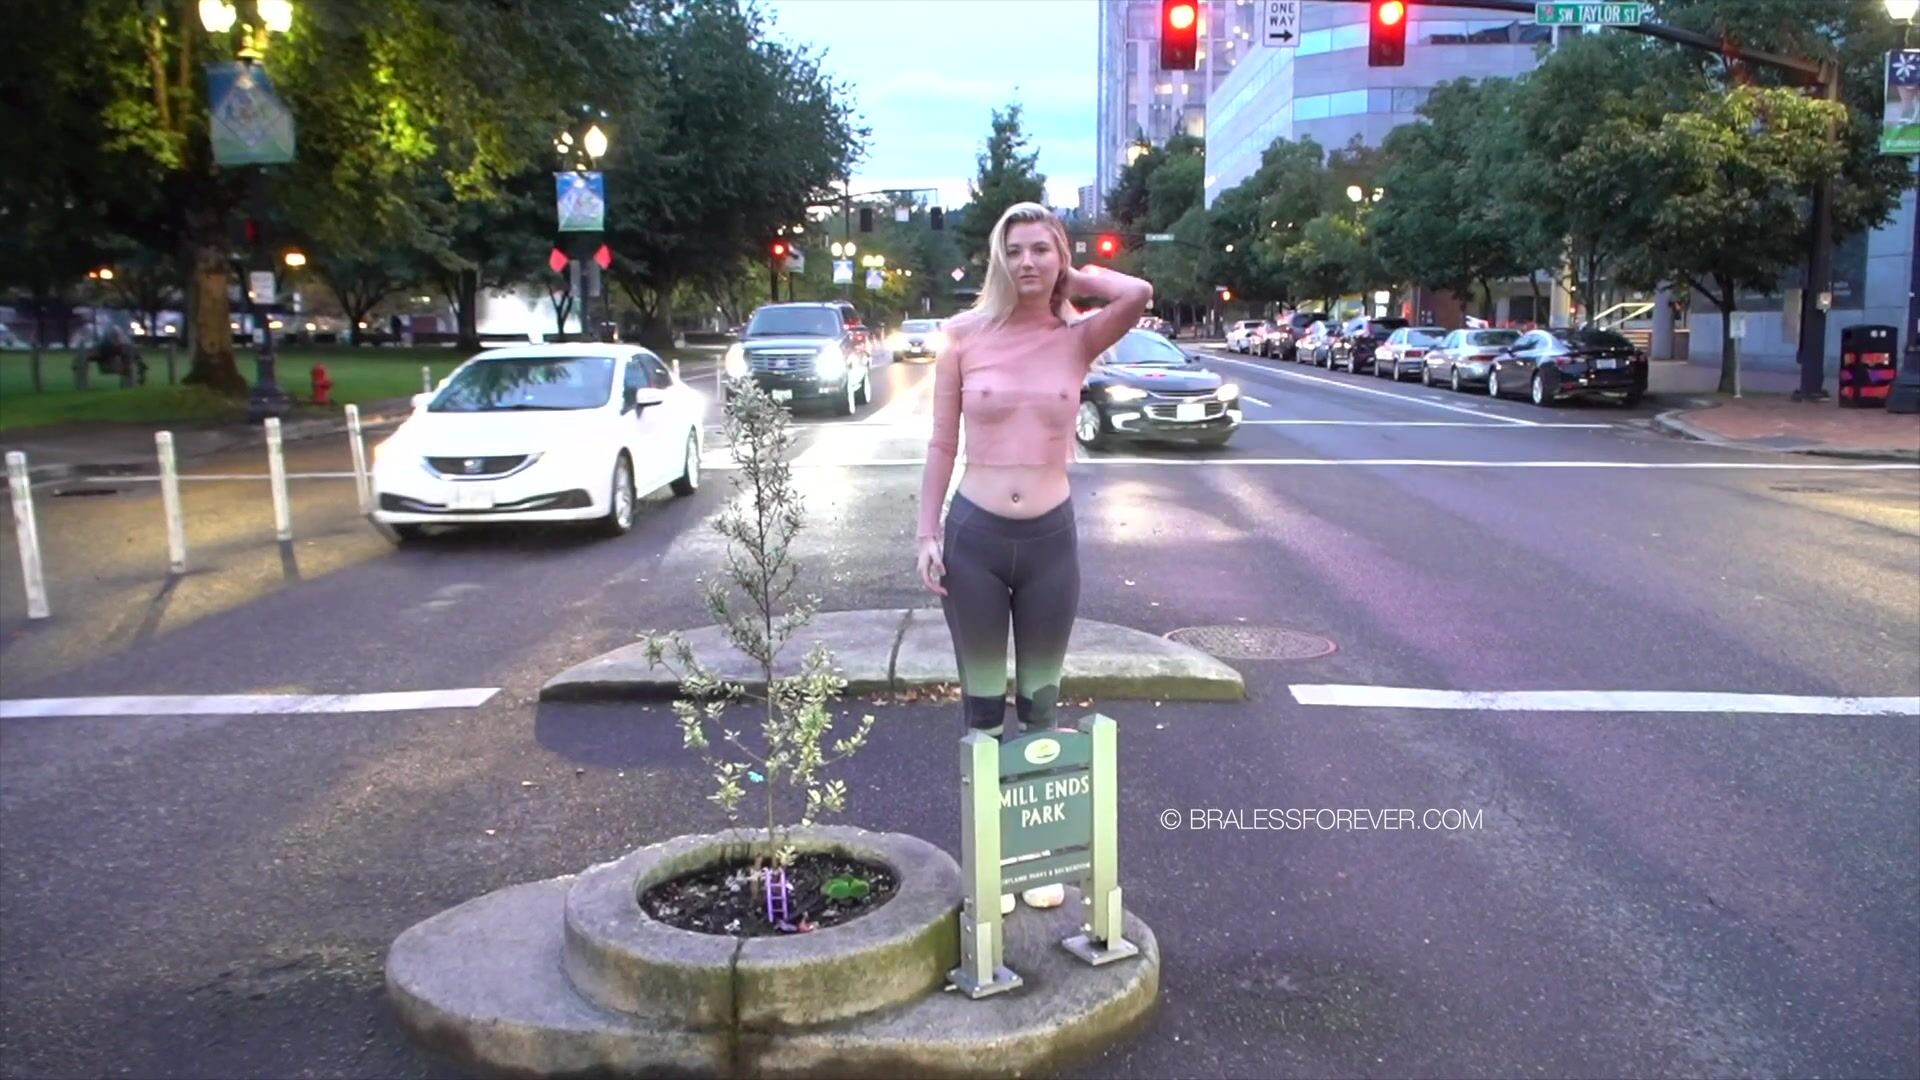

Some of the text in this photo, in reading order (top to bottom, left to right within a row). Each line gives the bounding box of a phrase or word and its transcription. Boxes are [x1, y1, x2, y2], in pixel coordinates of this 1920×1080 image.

[1271, 2, 1295, 13] ONE
[1559, 5, 1635, 22] SW TAYLOR ST
[1270, 15, 1295, 26] WAY
[999, 775, 1089, 808] MILL ENDS
[1022, 802, 1065, 828] PARK
